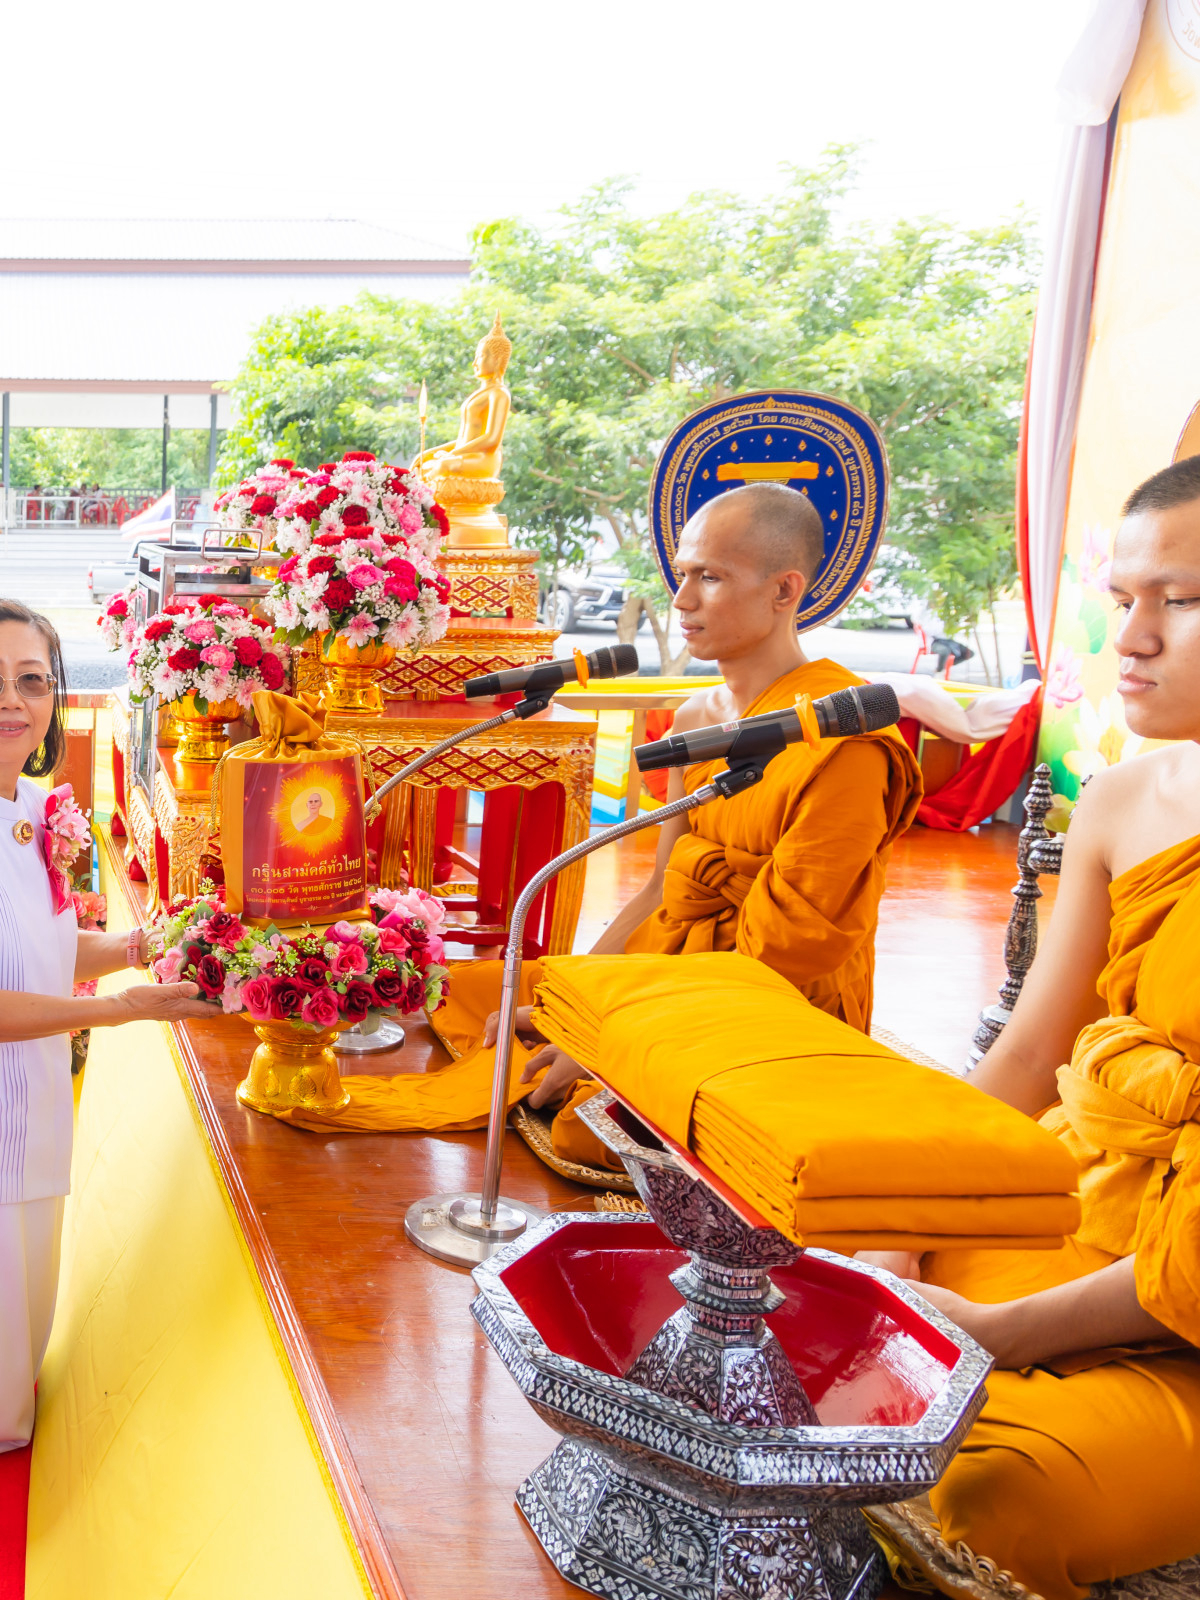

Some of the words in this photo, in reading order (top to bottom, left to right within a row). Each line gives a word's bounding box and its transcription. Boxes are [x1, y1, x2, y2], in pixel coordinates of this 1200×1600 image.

[757, 413, 778, 424] โดย
[251, 854, 361, 882] กฐินสามัคคีทั่วไทย
[287, 884, 299, 894] วัด
[301, 881, 342, 895] พุทธศักราช
